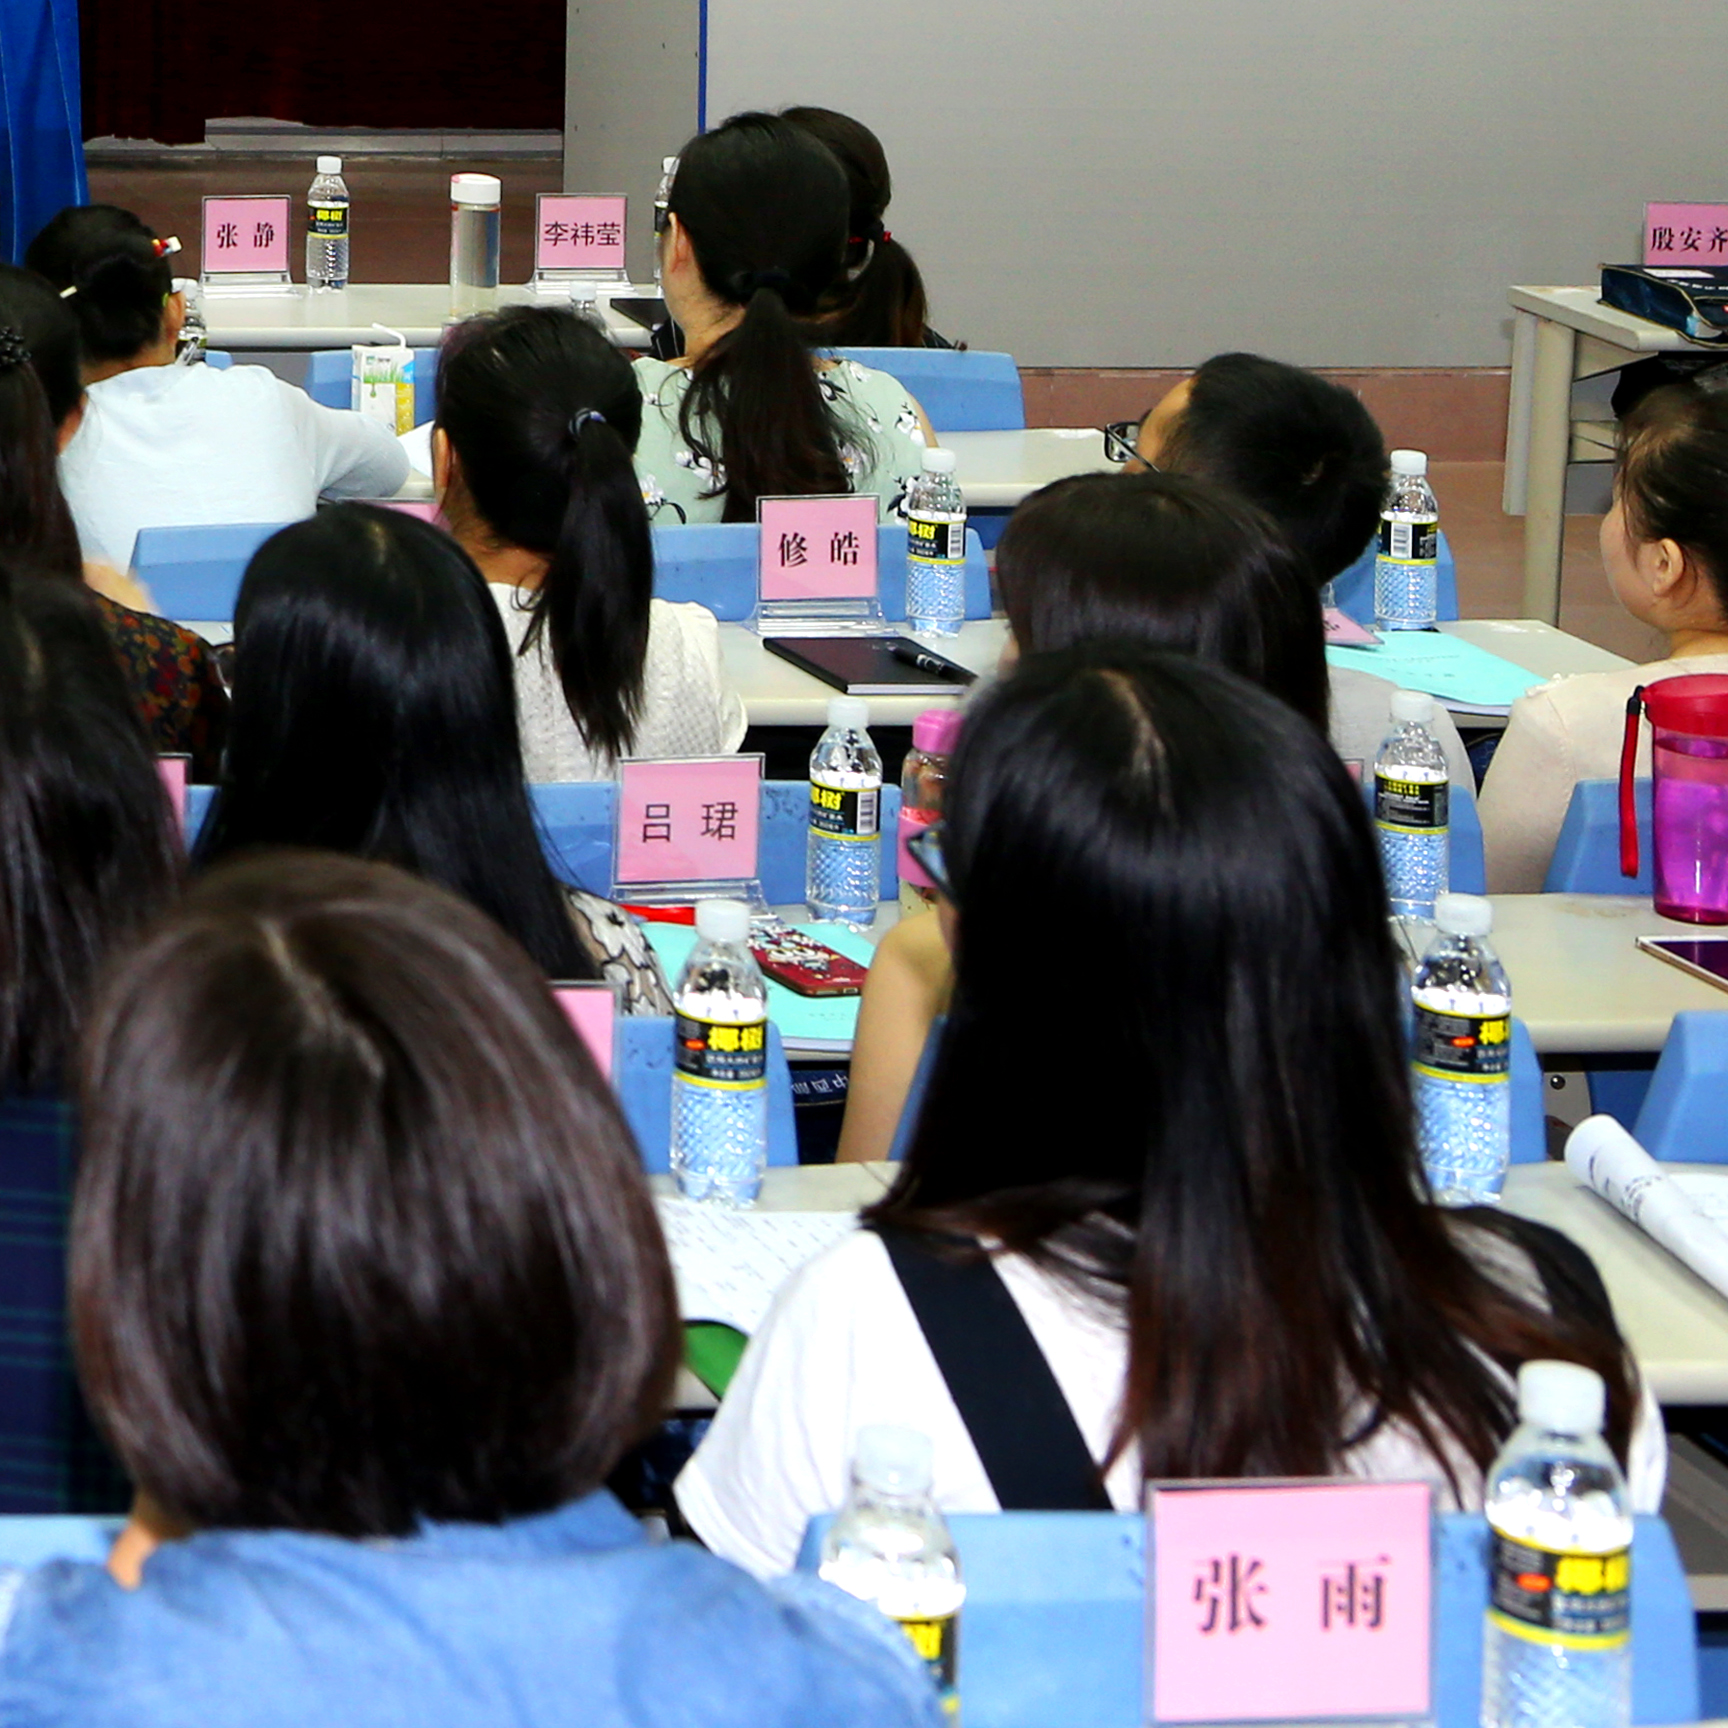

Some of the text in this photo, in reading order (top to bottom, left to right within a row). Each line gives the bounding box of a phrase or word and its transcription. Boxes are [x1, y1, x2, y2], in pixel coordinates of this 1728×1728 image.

[216, 222, 276, 249] 张静
[778, 531, 861, 569] 修皓
[641, 801, 739, 844] 吕珺
[1192, 1553, 1393, 1635] 张雨
